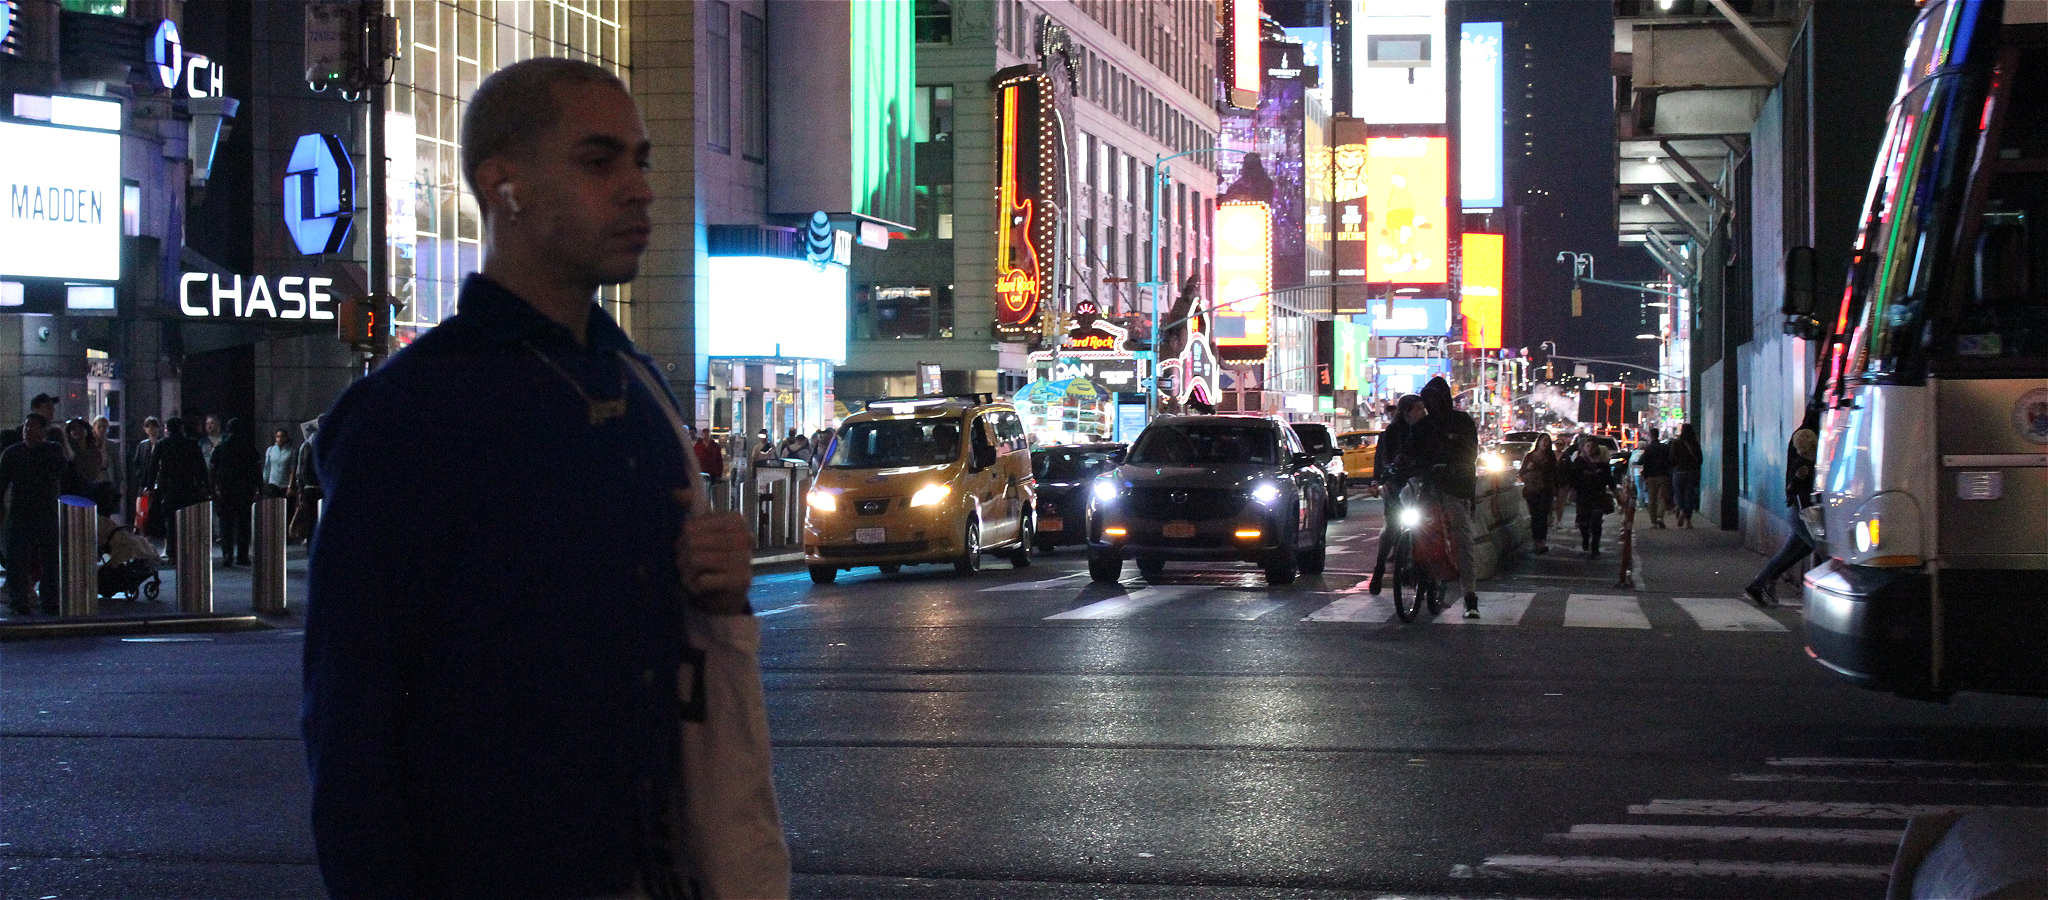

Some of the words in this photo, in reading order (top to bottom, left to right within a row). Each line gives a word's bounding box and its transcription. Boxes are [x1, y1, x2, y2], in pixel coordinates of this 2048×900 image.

[187, 57, 223, 98] CH
[12, 183, 102, 224] MADDEN
[180, 272, 334, 319] CHASE
[997, 277, 1015, 293] Hard
[1015, 275, 1036, 295] Rock
[1063, 337, 1089, 348] ard
[1089, 335, 1114, 350] Rock
